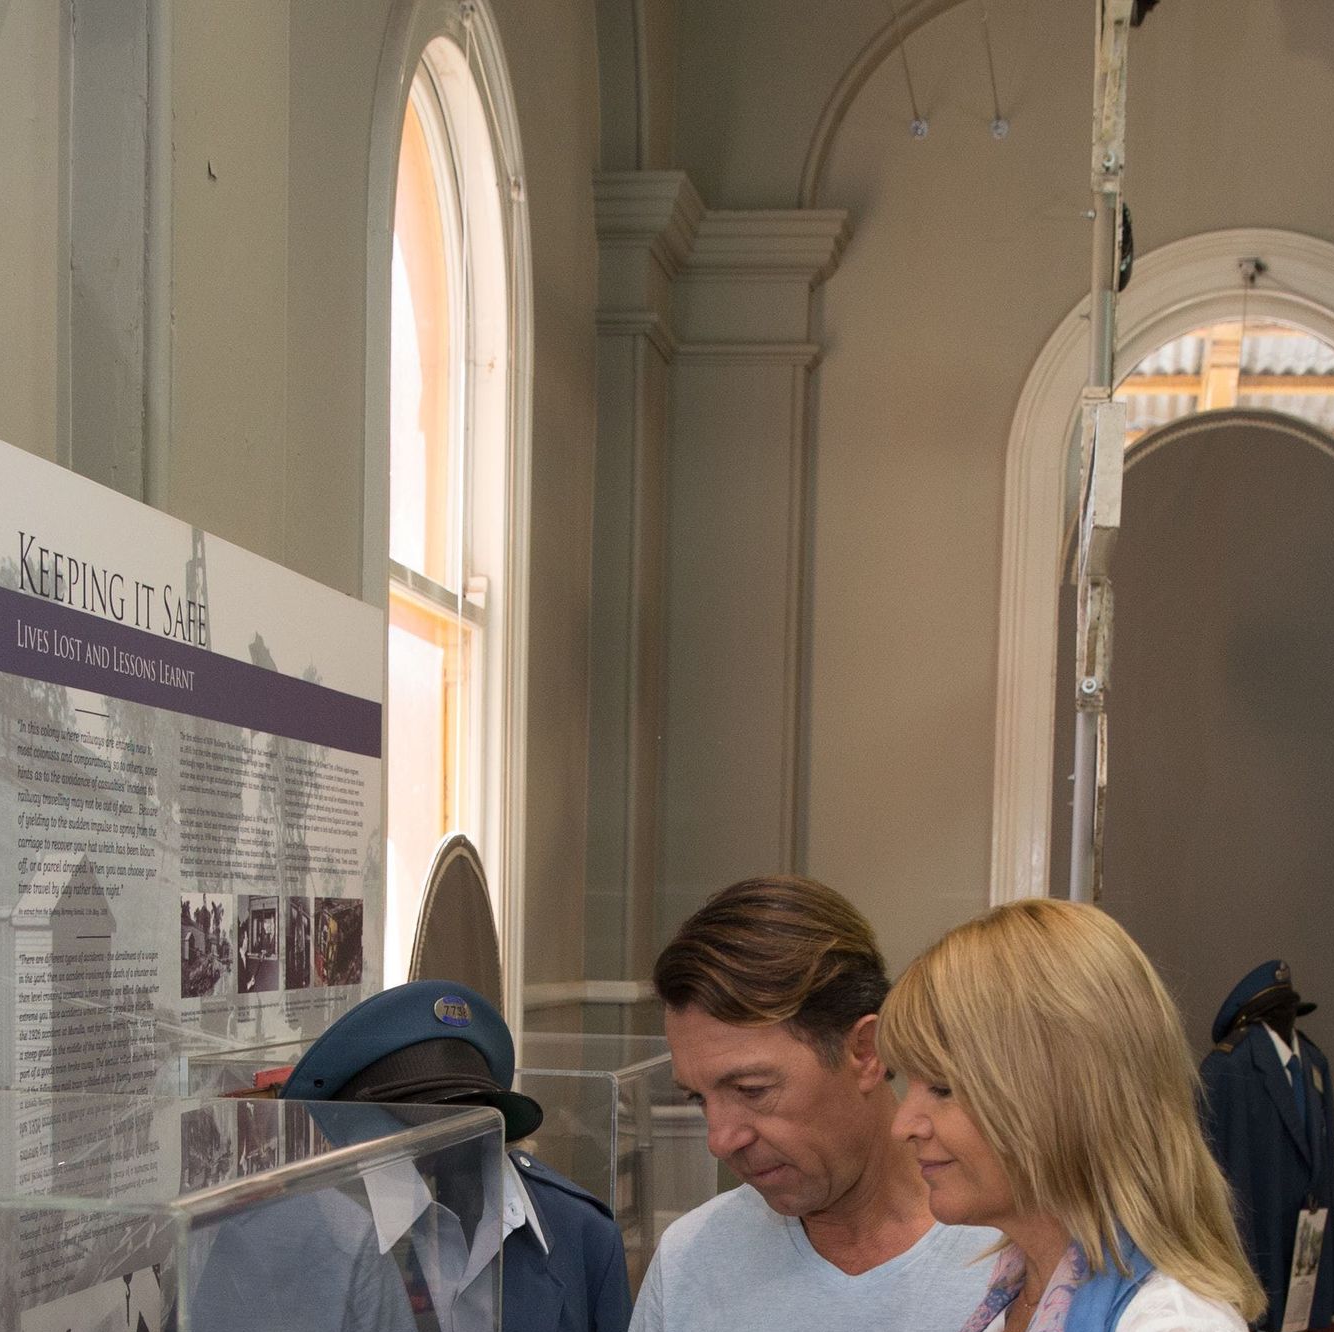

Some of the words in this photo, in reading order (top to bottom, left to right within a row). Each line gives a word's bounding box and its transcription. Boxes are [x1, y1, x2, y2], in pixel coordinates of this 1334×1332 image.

[18, 531, 125, 621] KEEPING
[134, 579, 155, 631] IT
[163, 584, 208, 647] SAFE
[16, 619, 49, 655] LIVES
[54, 628, 82, 662] LOST
[85, 644, 110, 669] AND
[113, 647, 156, 683] LESSONS
[159, 658, 195, 692] LEARNT
